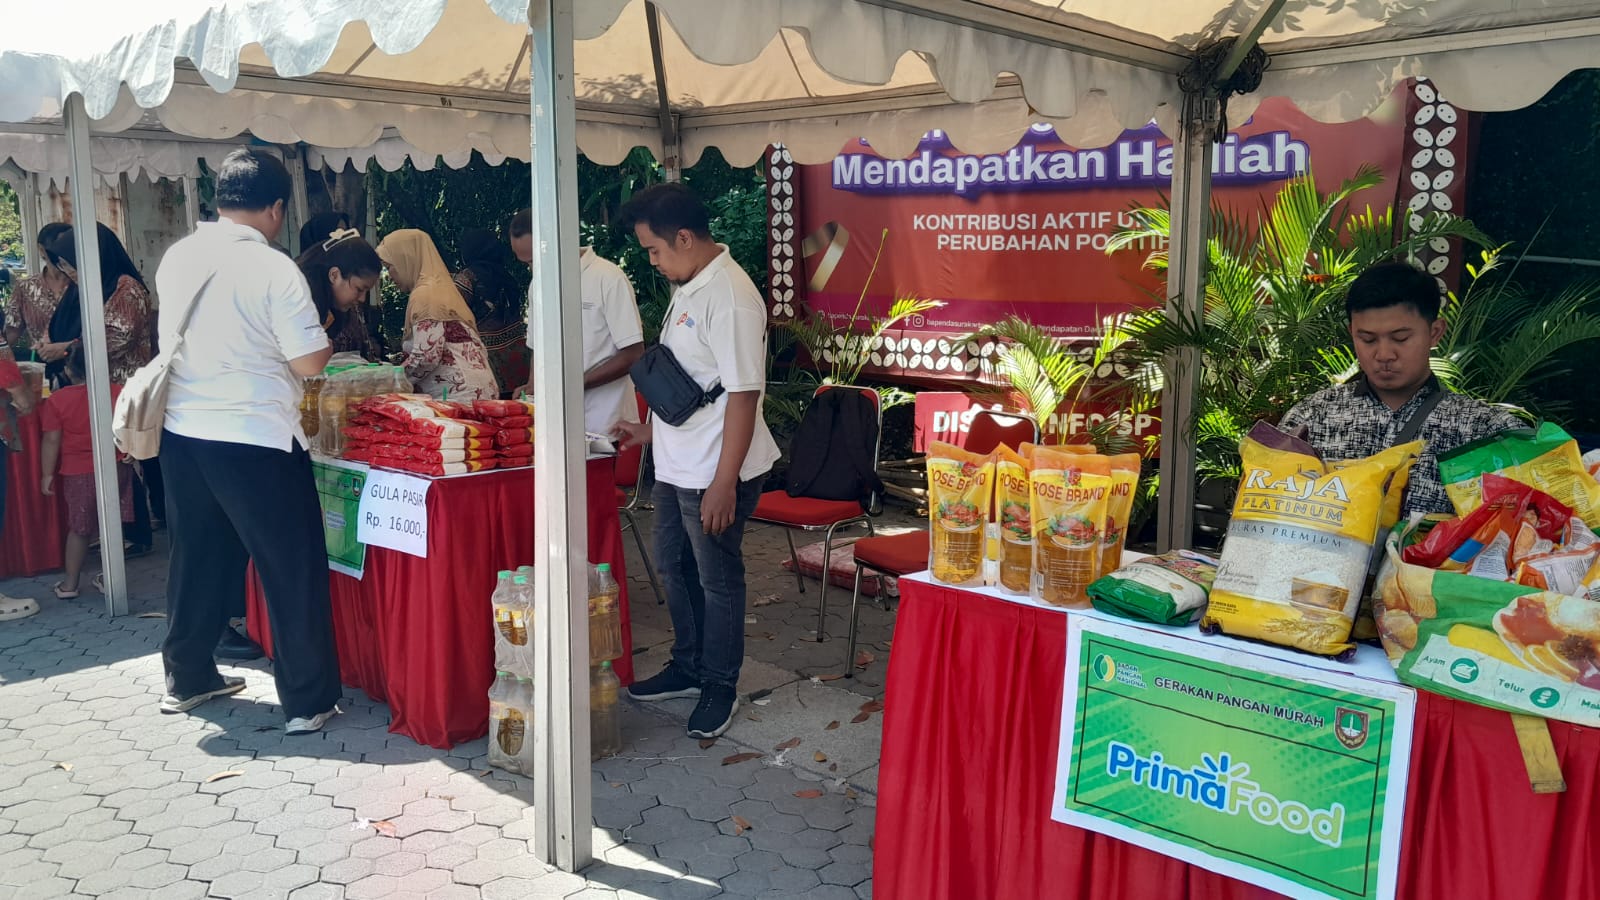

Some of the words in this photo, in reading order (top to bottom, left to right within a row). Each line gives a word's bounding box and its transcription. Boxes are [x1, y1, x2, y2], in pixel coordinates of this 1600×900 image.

[833, 146, 1105, 191] Mendapatkan
[1119, 133, 1306, 176] Haiah
[913, 213, 1037, 231] KONTRIBUSI
[1042, 211, 1111, 230] AKTIF
[937, 234, 1069, 251] PERUBAHAN
[370, 484, 399, 502] GULA
[402, 489, 424, 507] PASIR
[1066, 487, 1105, 501] BRAND
[1245, 468, 1351, 503] RAJA
[1241, 497, 1343, 521] PLATINUM
[366, 511, 382, 529] Rp.
[390, 516, 425, 538] 16.000,-
[1272, 527, 1342, 548] PREMIUM
[1423, 655, 1446, 666] Ayam
[1498, 679, 1525, 693] Telur
[1154, 677, 1213, 700] GERAKAN
[1216, 693, 1270, 714] PANGAN
[1273, 706, 1324, 727] MURAH
[1108, 742, 1343, 845] PrimaFood
